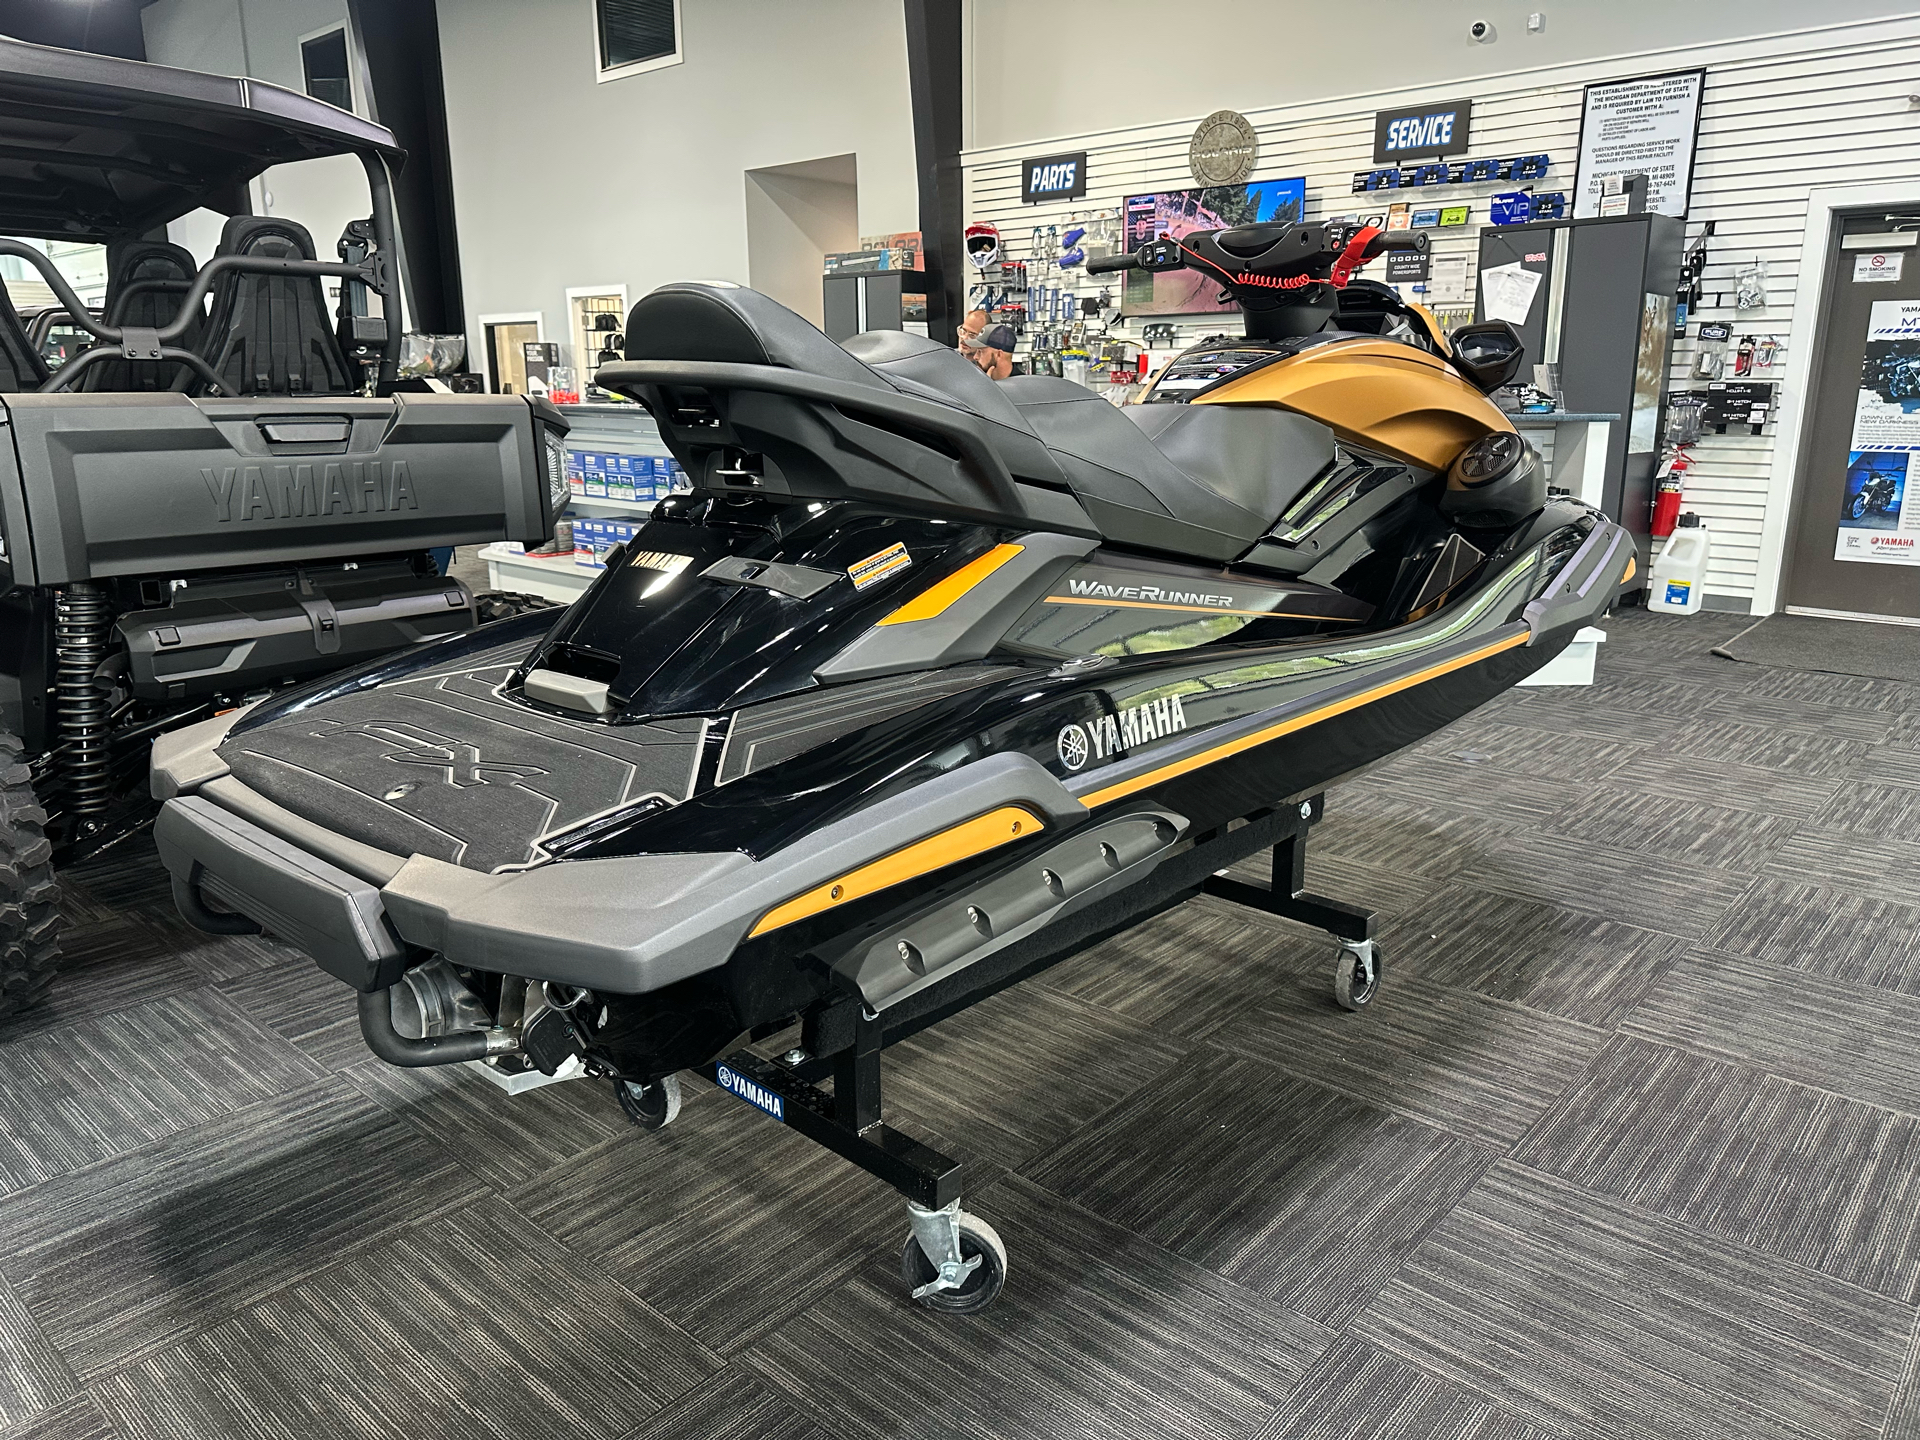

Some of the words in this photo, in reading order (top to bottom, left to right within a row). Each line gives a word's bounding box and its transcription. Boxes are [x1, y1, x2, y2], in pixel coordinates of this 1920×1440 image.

[1602, 85, 1642, 95] ESTABLISHMENT
[1650, 80, 1682, 88] STERED
[1631, 89, 1664, 98] DEPARTMENT
[1609, 100, 1633, 108] REQUIRED
[1663, 93, 1685, 101] FURNISH
[1616, 106, 1643, 115] CUSTOMER
[1196, 114, 1224, 140] SINCE
[1230, 114, 1249, 135] 1954
[1387, 113, 1454, 150] SERVICE
[1192, 145, 1252, 159] POLARIS
[1030, 162, 1076, 193] PARTS
[1193, 170, 1212, 187] THIN
[1502, 203, 1528, 215] VIP
[200, 460, 418, 522] YAMAHA
[1880, 538, 1914, 546] YAMAHA
[630, 551, 694, 574] YAMAH
[1086, 693, 1186, 759] YAMAHA
[732, 1073, 781, 1117] YAMAHA
